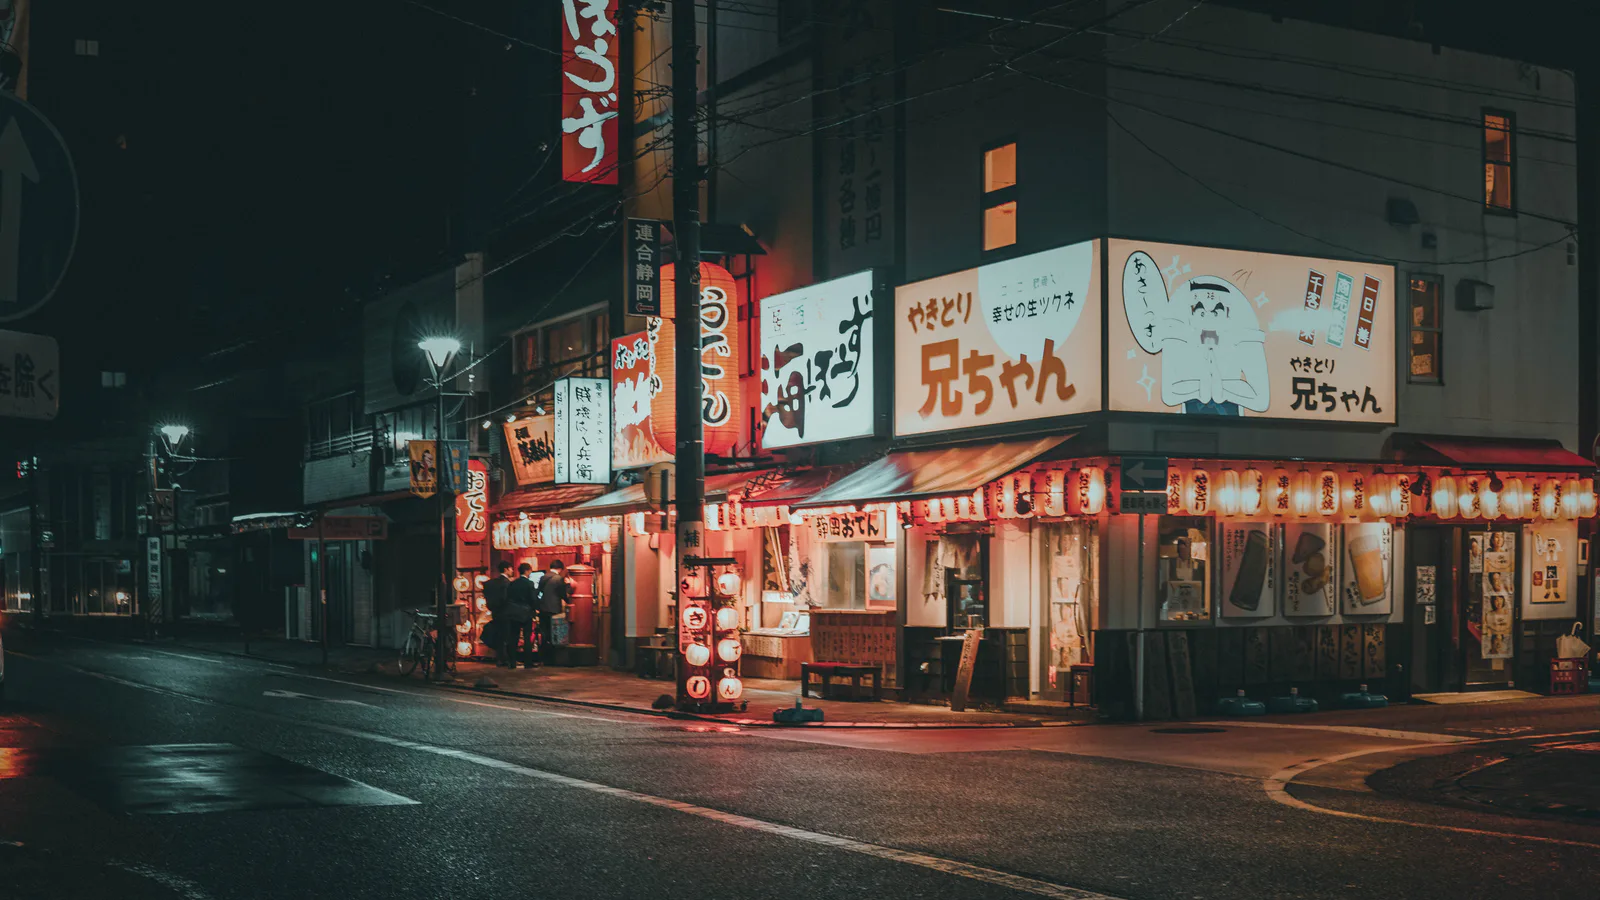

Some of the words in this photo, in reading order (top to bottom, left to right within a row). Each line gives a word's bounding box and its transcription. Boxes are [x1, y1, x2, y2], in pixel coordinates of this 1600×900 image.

[634, 223, 655, 302] 連合静岡
[907, 291, 972, 335] やきとり
[992, 290, 1075, 324] 幸せの生ツクネ
[1299, 275, 1323, 341] 千客来
[1357, 285, 1377, 345] 一日一善
[760, 290, 874, 439] 海ぼうず
[918, 338, 1077, 420] 兄ちゃん
[1290, 356, 1335, 375] やきとり
[1290, 376, 1383, 415] 兄ちゃん
[464, 470, 486, 532] おでん
